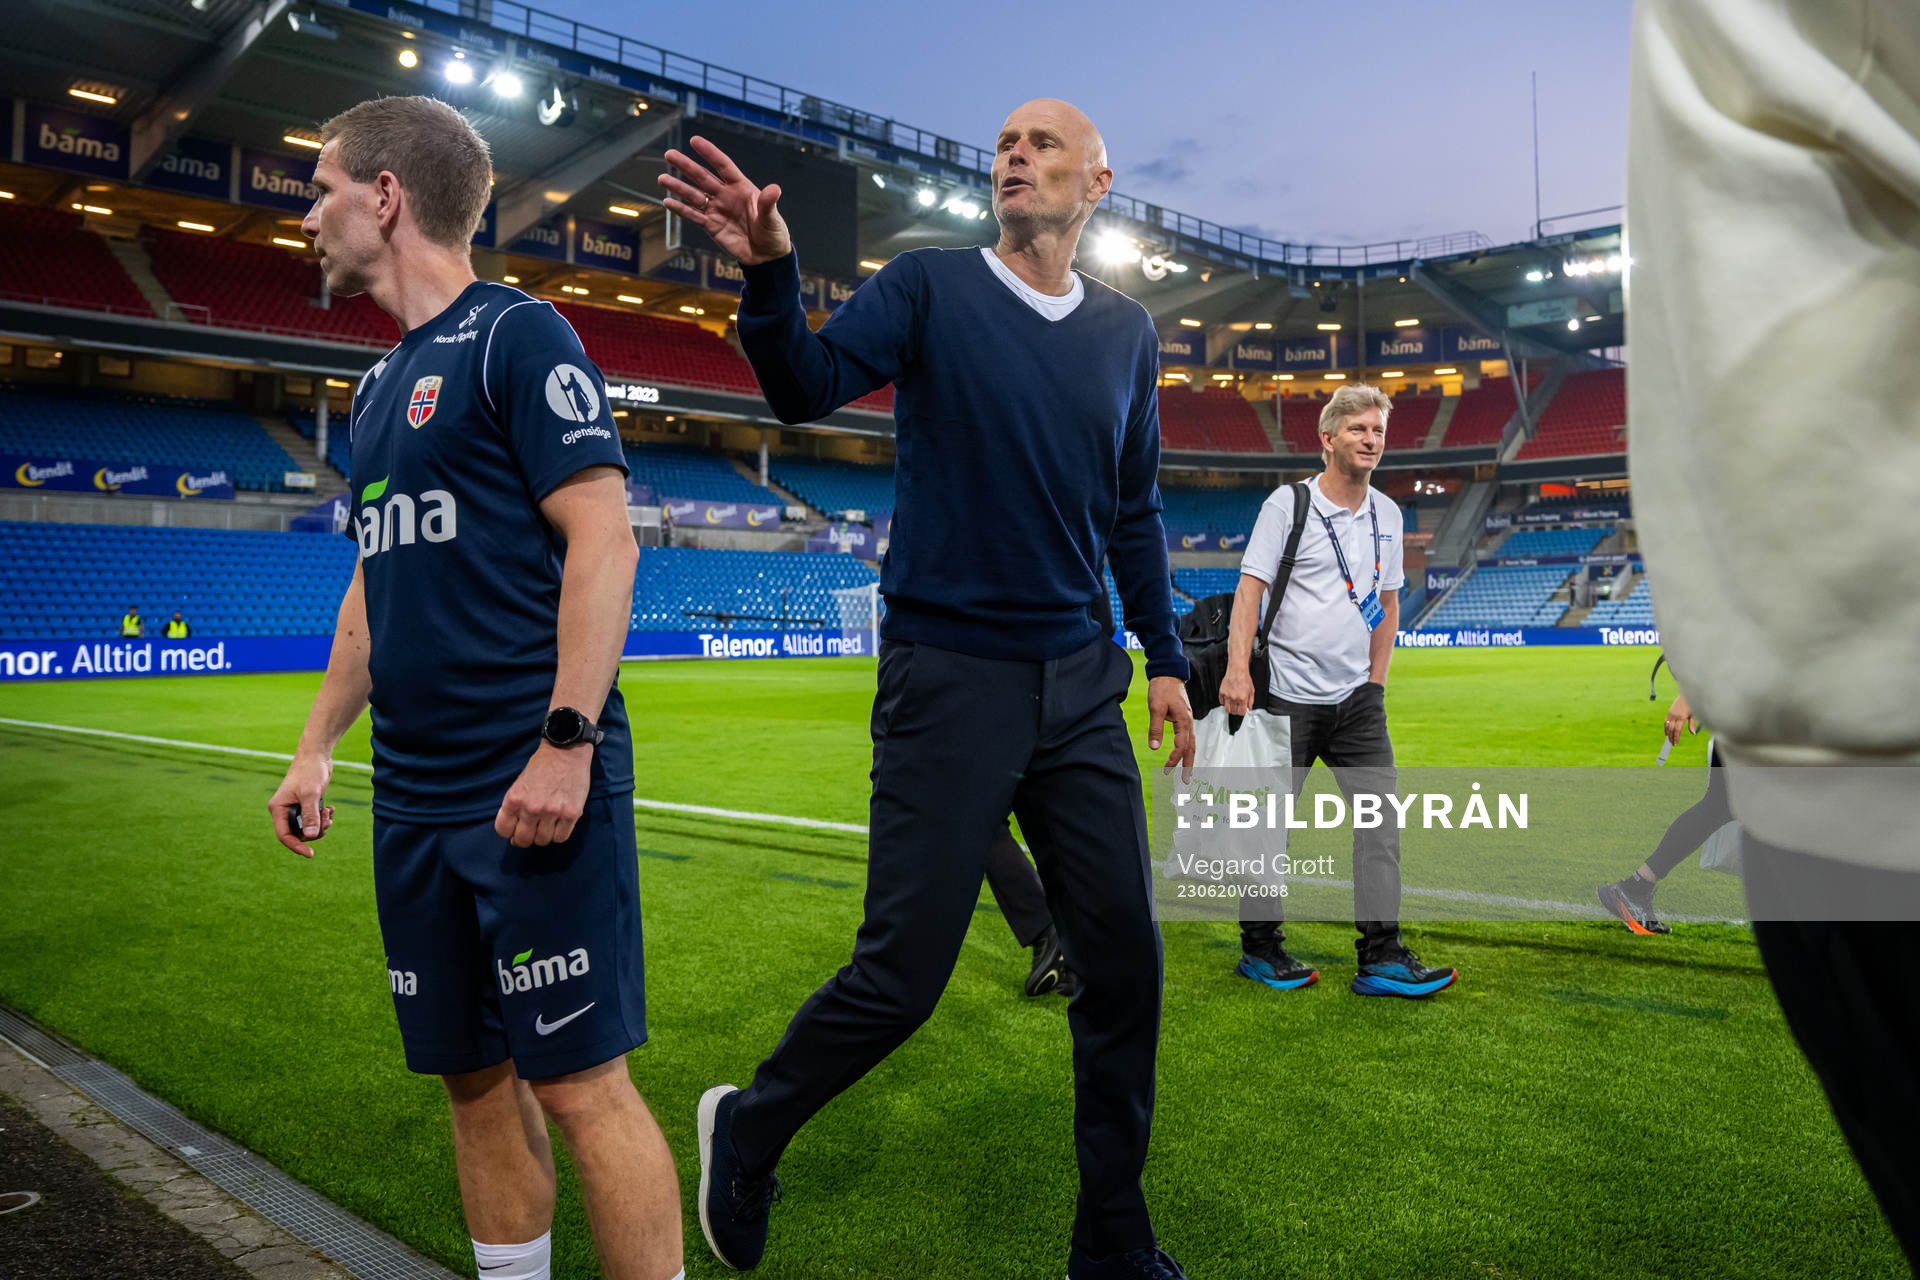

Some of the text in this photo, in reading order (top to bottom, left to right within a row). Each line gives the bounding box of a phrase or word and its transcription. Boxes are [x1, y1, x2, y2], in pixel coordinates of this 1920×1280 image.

[38, 123, 121, 163] bama
[155, 151, 220, 181] ama
[582, 232, 632, 261] bama
[1237, 344, 1272, 361] bama
[1285, 347, 1325, 362] bama
[1381, 341, 1423, 355] bama
[562, 426, 611, 445] Gjensidige
[698, 633, 779, 657] Telenor.
[783, 633, 823, 655] Alltid
[1396, 630, 1525, 648] Telenor. Alltid med.
[72, 643, 152, 674] Alltid
[160, 642, 232, 671] med.
[498, 948, 590, 996] bama
